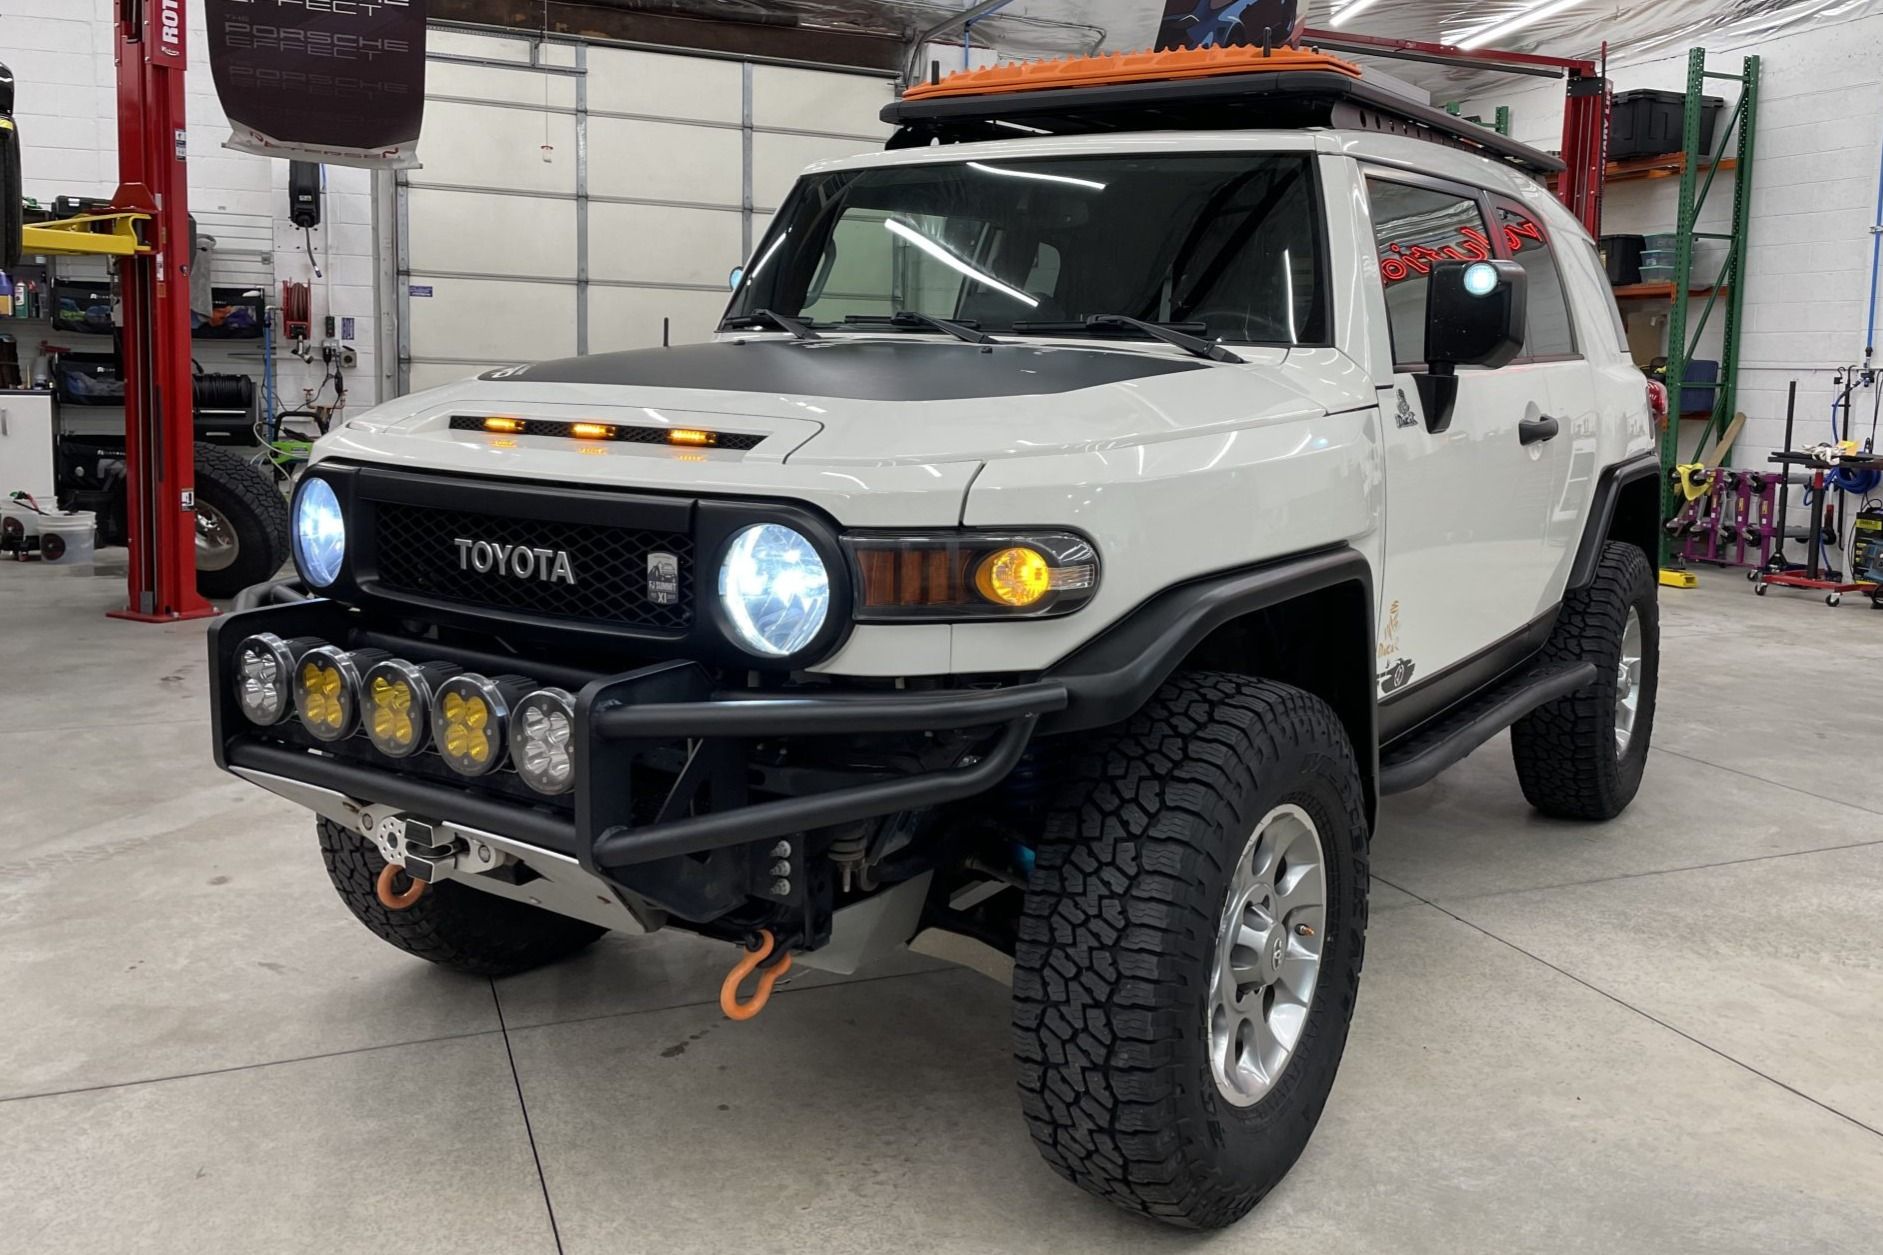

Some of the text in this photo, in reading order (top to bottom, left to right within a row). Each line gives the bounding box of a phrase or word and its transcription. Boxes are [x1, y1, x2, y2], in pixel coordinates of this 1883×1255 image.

[224, 22, 409, 52] PORSCHE
[225, 35, 383, 61] EFFECT
[228, 66, 409, 94] PORSCHE
[454, 538, 577, 585] TOYOTA
